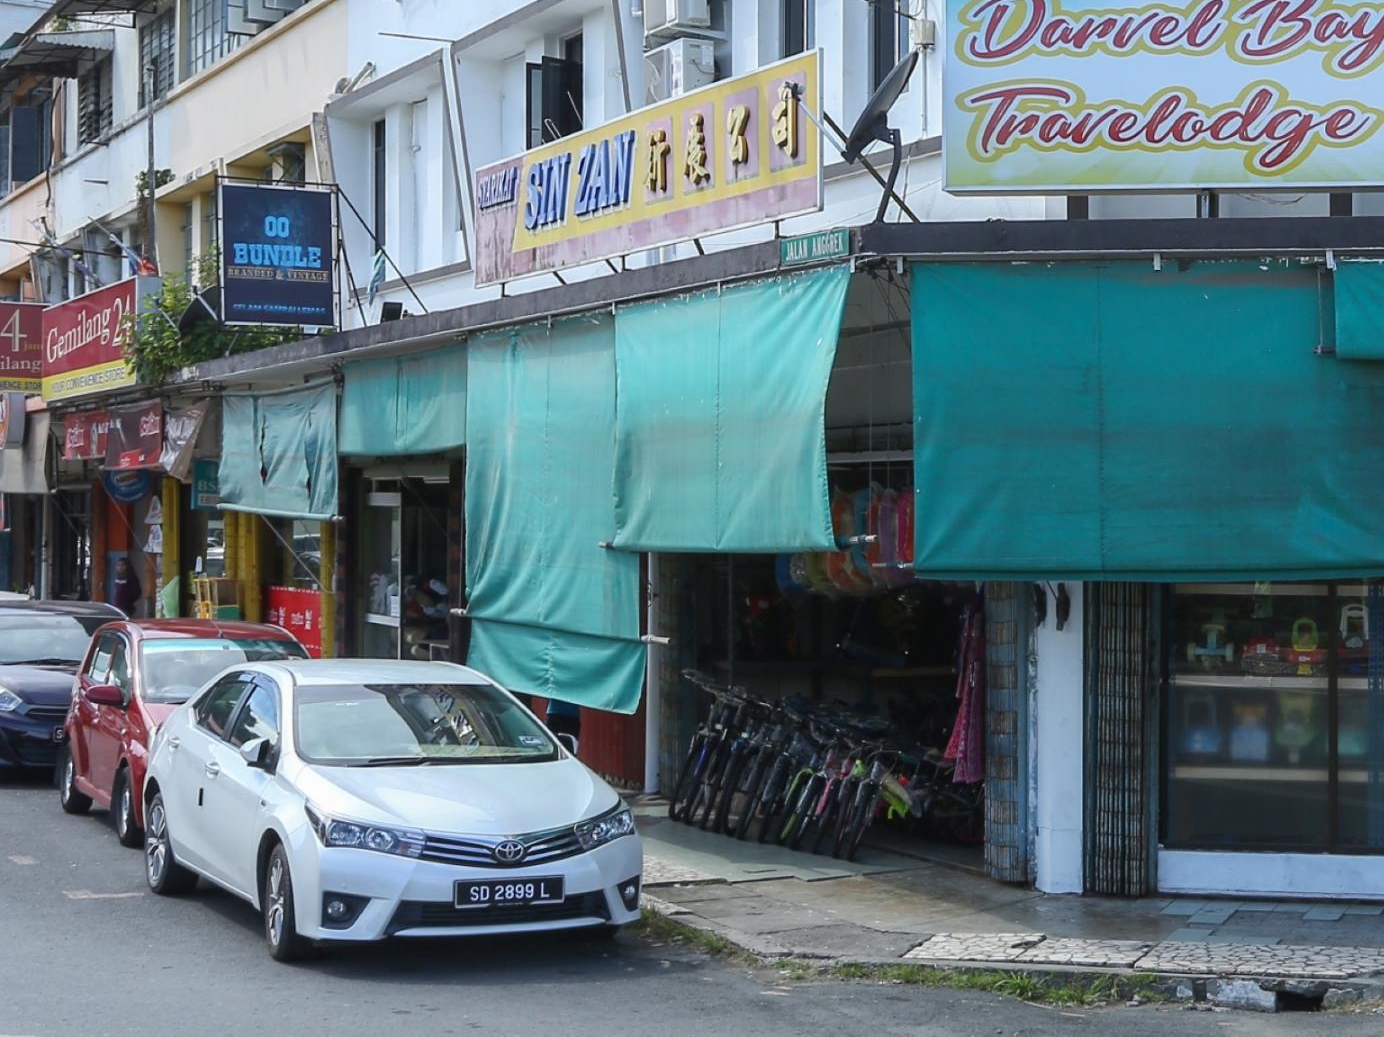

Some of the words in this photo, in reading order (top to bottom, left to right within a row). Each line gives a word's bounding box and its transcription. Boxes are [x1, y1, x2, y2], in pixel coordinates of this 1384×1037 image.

[967, 83, 1375, 171] Travelodge
[525, 152, 572, 230] SIN
[574, 130, 635, 216] ZAN
[233, 243, 321, 268] BUNDLE
[786, 239, 808, 261] JALAN
[229, 267, 273, 279] BRANDED
[275, 269, 284, 280] &
[288, 270, 328, 282] VINTAGE
[47, 307, 111, 363] Gemilang
[104, 367, 125, 383] STORE
[470, 885, 490, 901] SD
[494, 883, 535, 901] 2899
[540, 882, 550, 898] L
